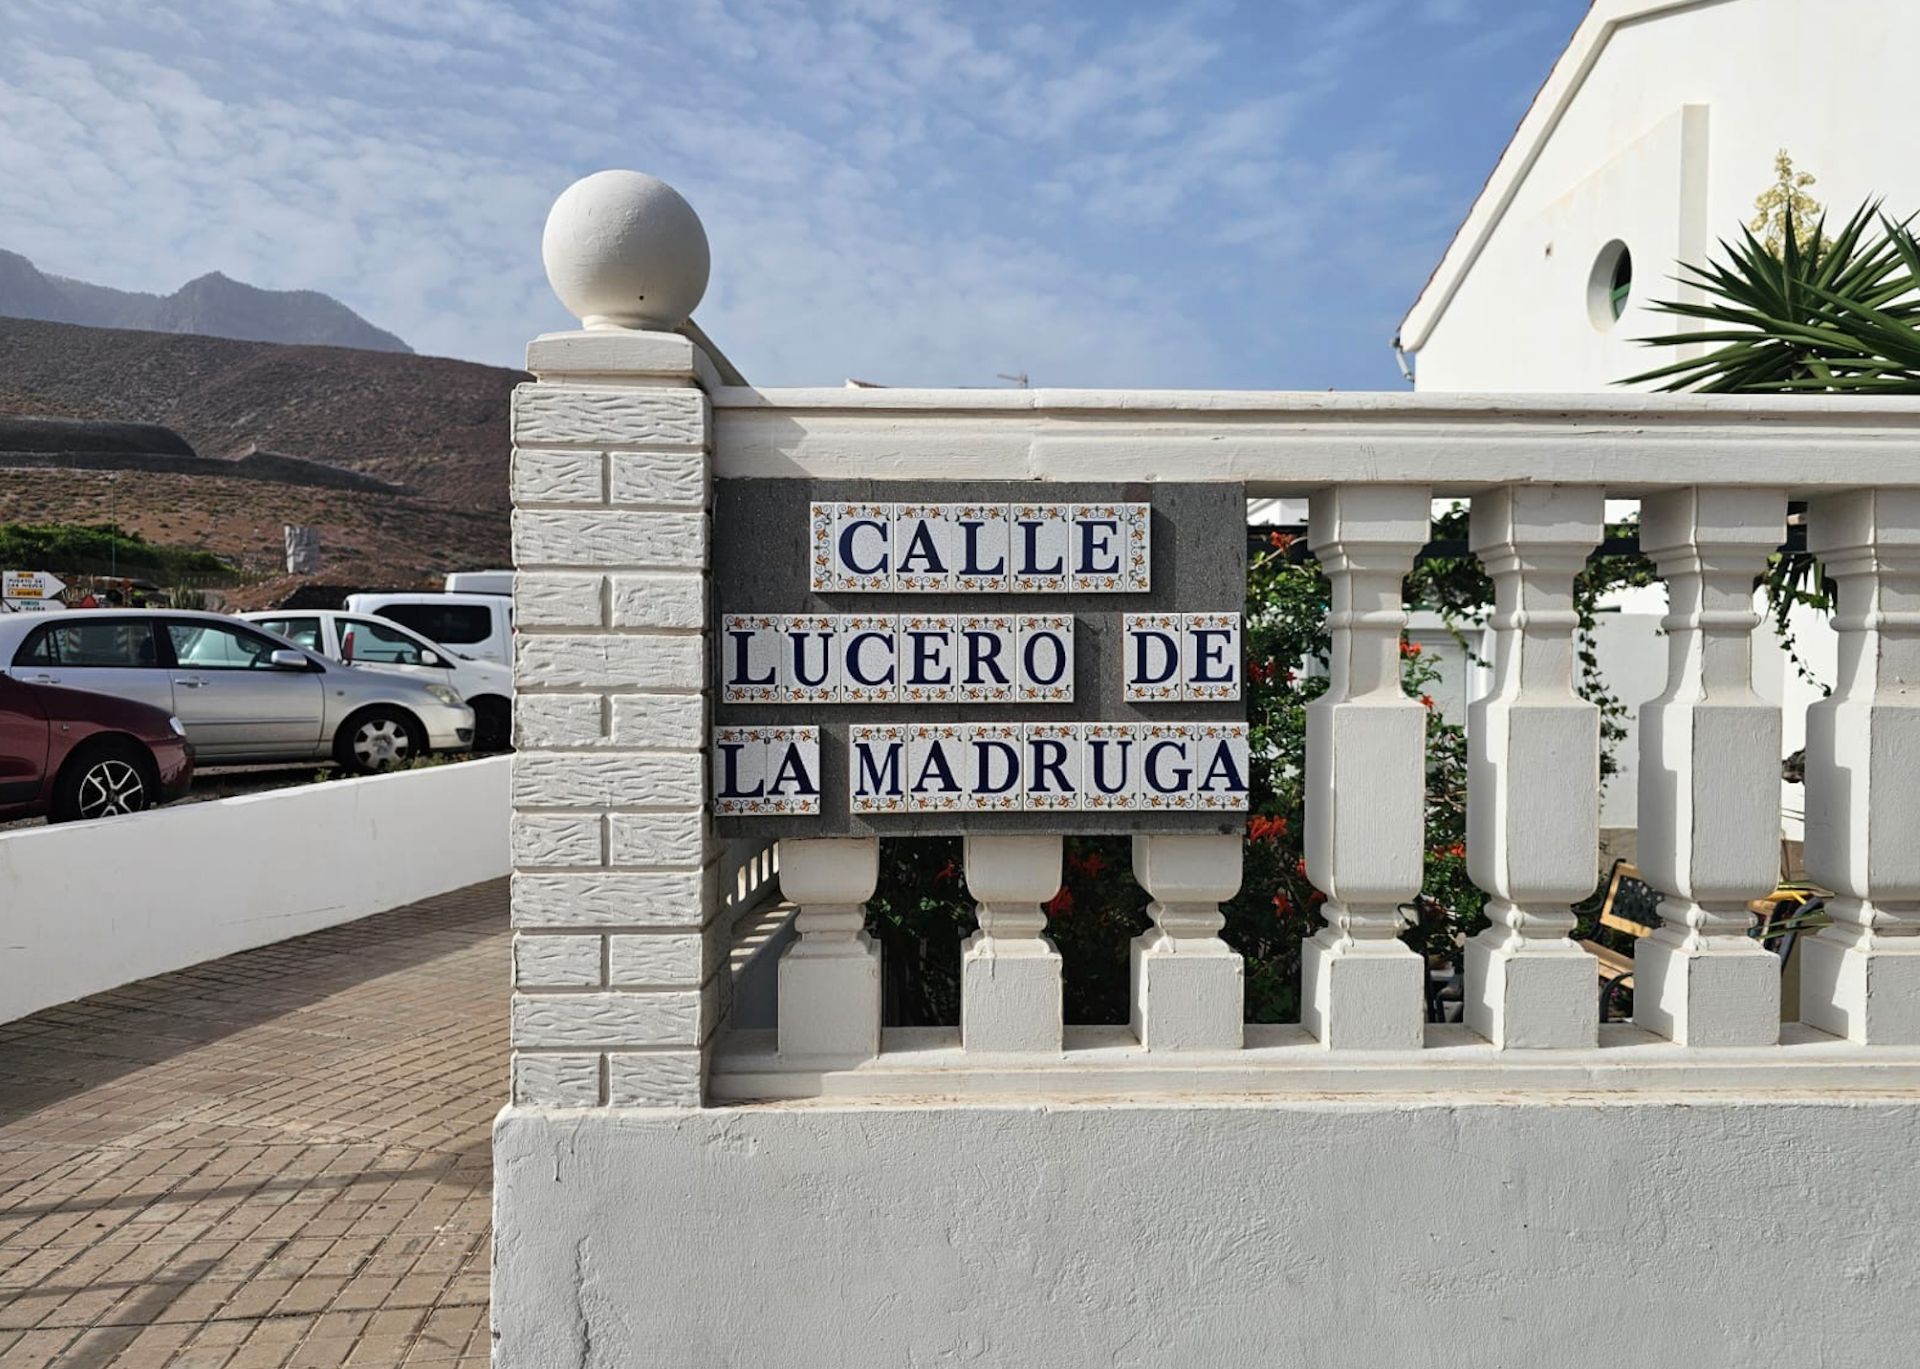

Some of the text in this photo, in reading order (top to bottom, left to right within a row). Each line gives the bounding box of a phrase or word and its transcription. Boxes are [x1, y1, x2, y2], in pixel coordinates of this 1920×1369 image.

[838, 519, 1120, 576] CALLE
[728, 629, 1235, 686] LUCERO DE
[717, 739, 1249, 799] LA MADRUGA
